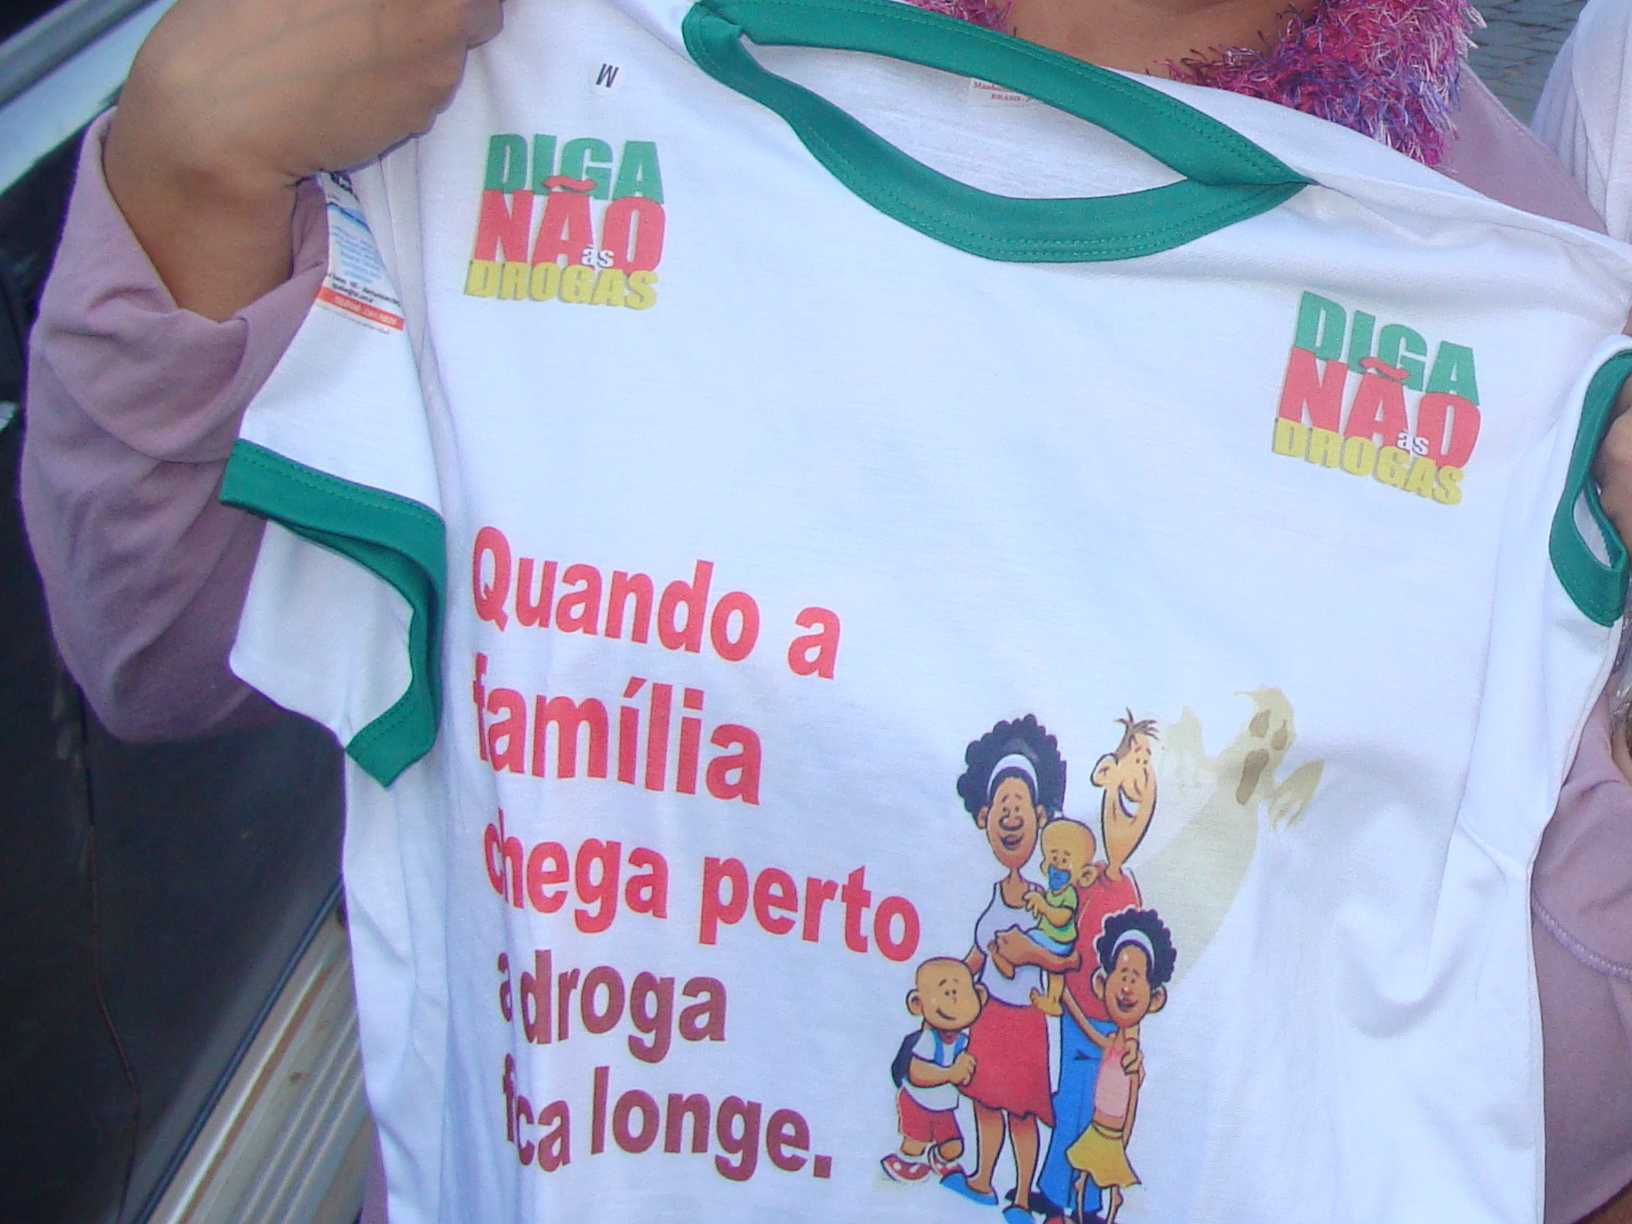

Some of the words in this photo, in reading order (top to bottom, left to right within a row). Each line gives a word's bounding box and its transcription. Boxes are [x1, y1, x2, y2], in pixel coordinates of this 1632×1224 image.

[482, 133, 665, 204] DIGA
[473, 174, 666, 275] NÃO
[580, 242, 615, 269] às
[463, 260, 659, 310] DROGAS
[1293, 290, 1480, 406] DIGA
[1278, 345, 1482, 469] NÃO
[1397, 429, 1430, 457] às
[1271, 417, 1466, 505] DROGAS
[472, 526, 760, 662] Quando
[786, 605, 842, 679] a
[472, 652, 763, 805] família
[699, 855, 922, 962] perto
[519, 948, 727, 1063] droga
[590, 1065, 833, 1181] longe.
